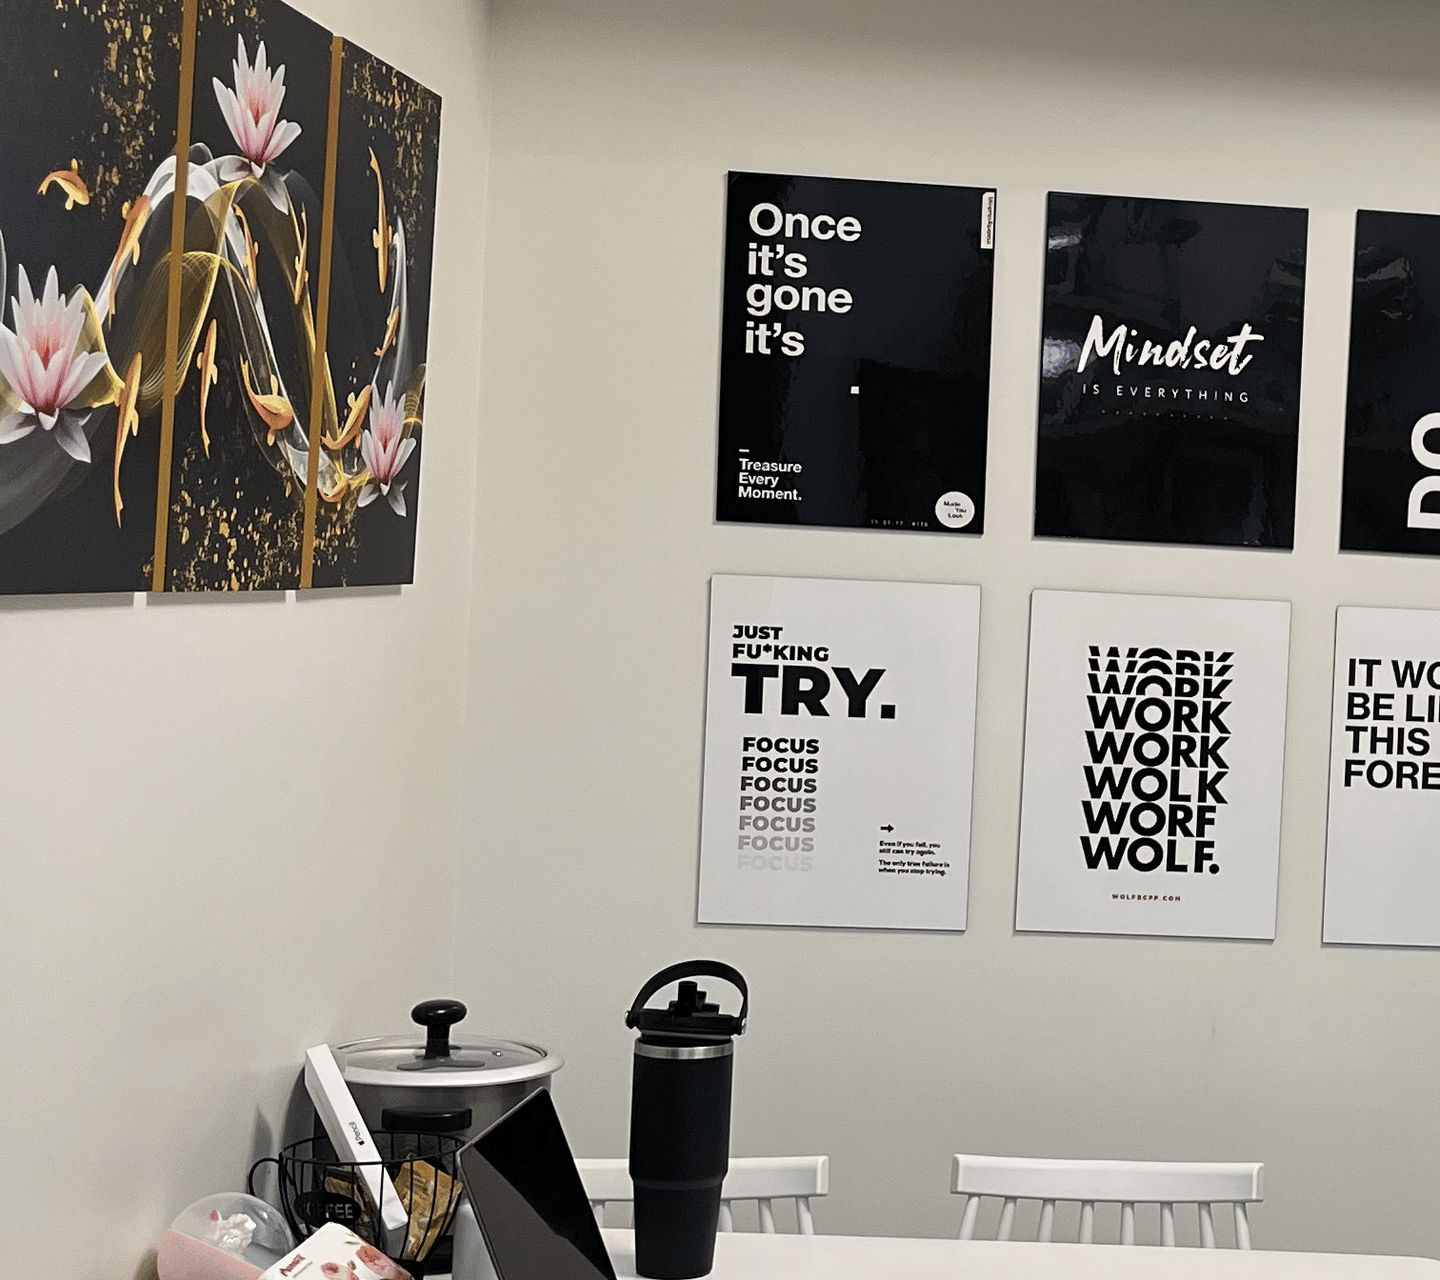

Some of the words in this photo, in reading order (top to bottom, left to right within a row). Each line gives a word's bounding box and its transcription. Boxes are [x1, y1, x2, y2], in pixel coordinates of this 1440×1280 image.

[749, 202, 862, 242] Once
[748, 243, 808, 278] it's
[746, 283, 853, 316] gone
[745, 321, 804, 356] it's
[1077, 315, 1265, 376] Mindset
[1082, 383, 1100, 395] IS
[1116, 385, 1249, 403] EVERYTHING
[739, 458, 802, 473] Treasure
[738, 473, 779, 488] Every
[738, 486, 802, 501] Moment.
[732, 624, 783, 640] JUST
[1348, 658, 1381, 687] IT
[731, 662, 896, 720] TRY.
[1086, 695, 1232, 734] WORK
[1347, 692, 1394, 721] BE
[743, 737, 819, 754] FOCUS
[1085, 730, 1230, 769] WORK
[1345, 725, 1430, 756] THIS
[742, 757, 818, 773] FOCUS
[740, 776, 817, 793] FOCUS
[1083, 765, 1229, 805] WOLK
[740, 796, 816, 813] FOCUS
[1081, 800, 1217, 838] WORF
[739, 816, 815, 832] FOCUS
[738, 835, 814, 852] FOCUS
[1079, 836, 1220, 875] WOLF.
[348, 1121, 363, 1140] Pencil
